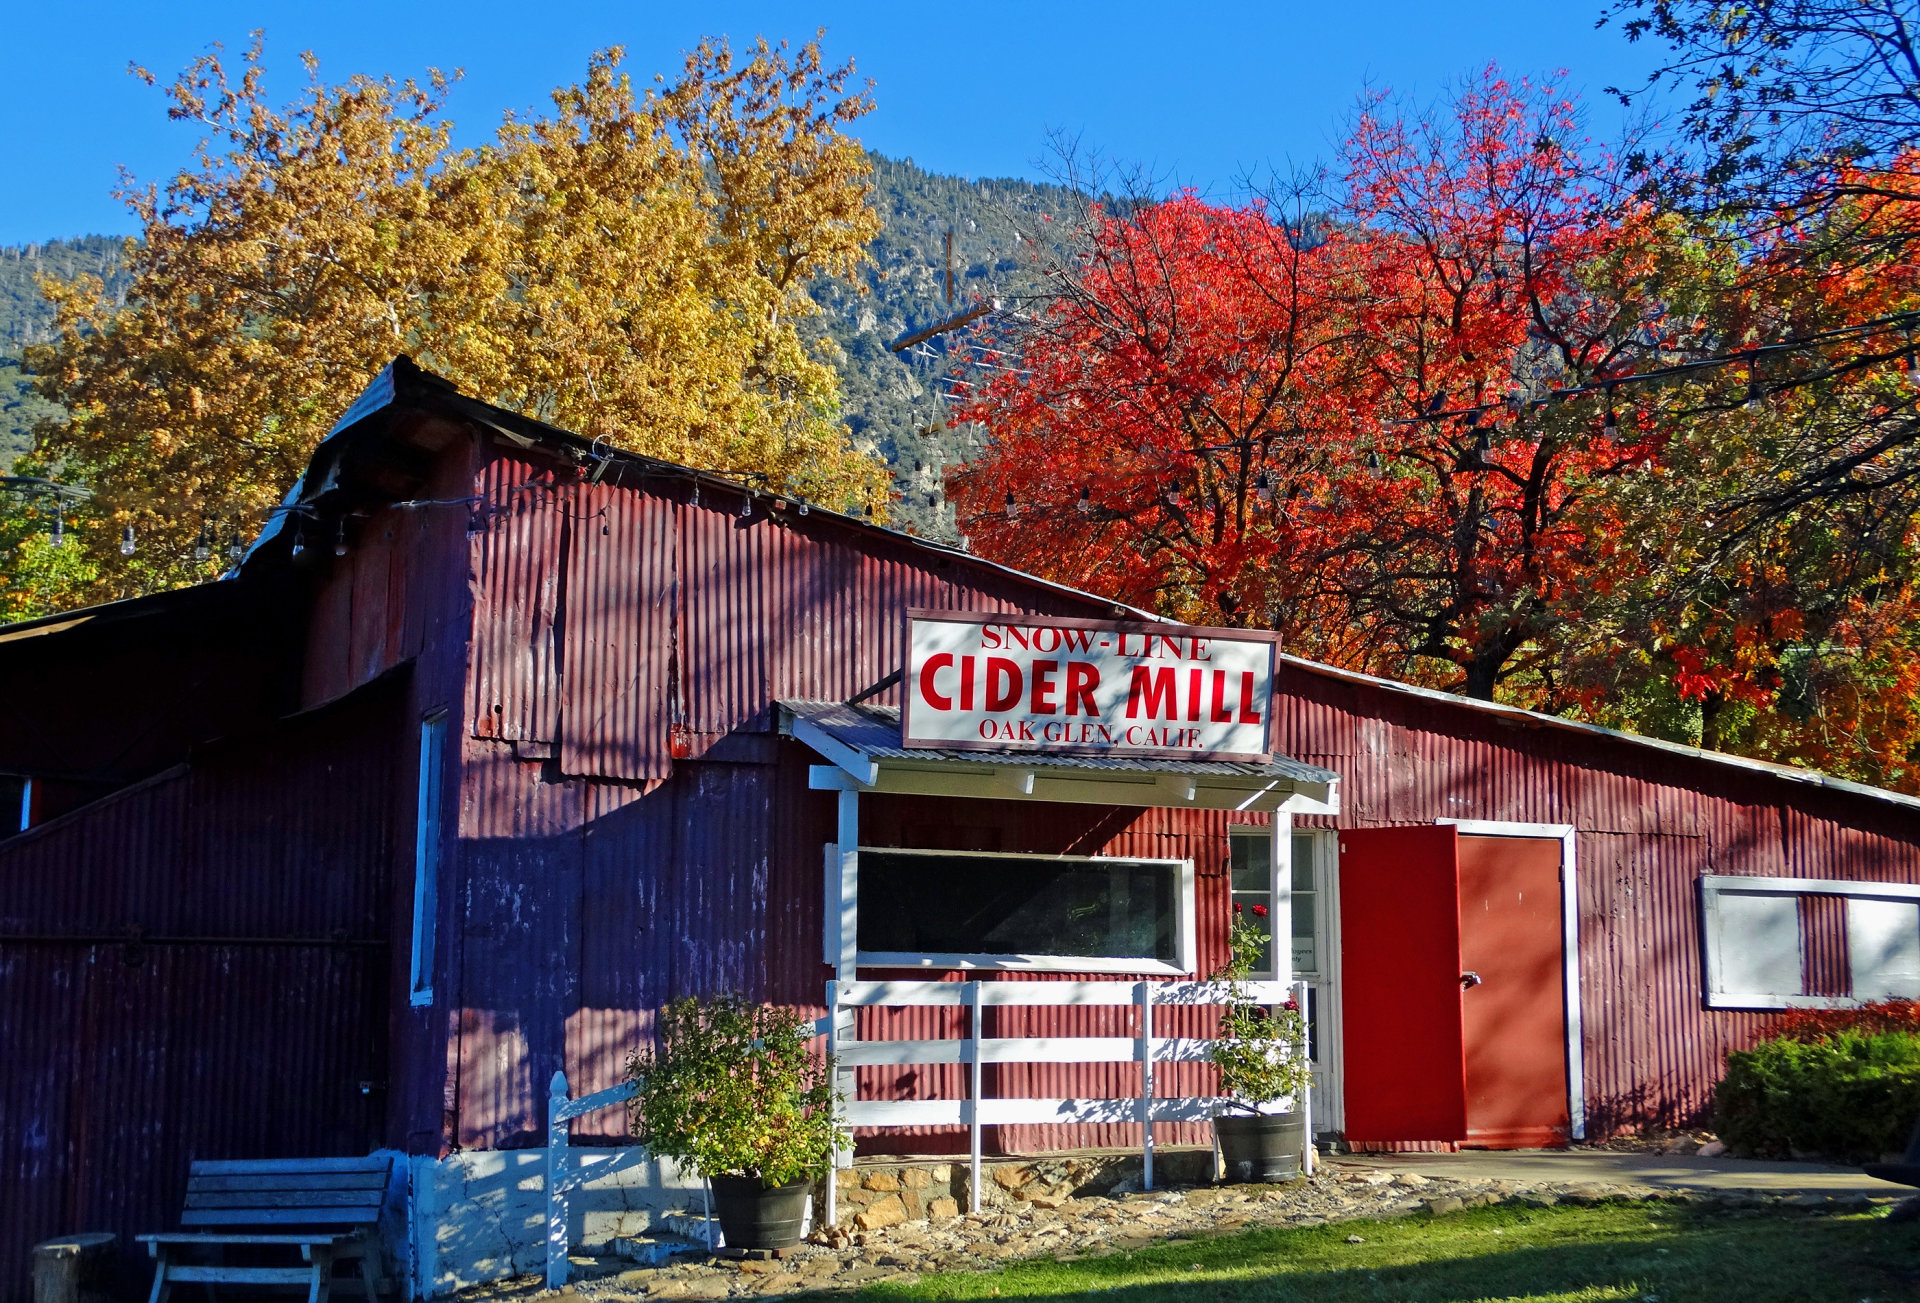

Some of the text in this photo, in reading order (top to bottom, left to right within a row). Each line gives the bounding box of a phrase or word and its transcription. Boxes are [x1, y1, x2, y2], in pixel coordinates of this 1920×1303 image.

[981, 624, 1212, 662] SNOW-LINE
[919, 653, 1261, 725] CIDER MILL
[979, 718, 1203, 749] OAK GLEN, CALIF.
